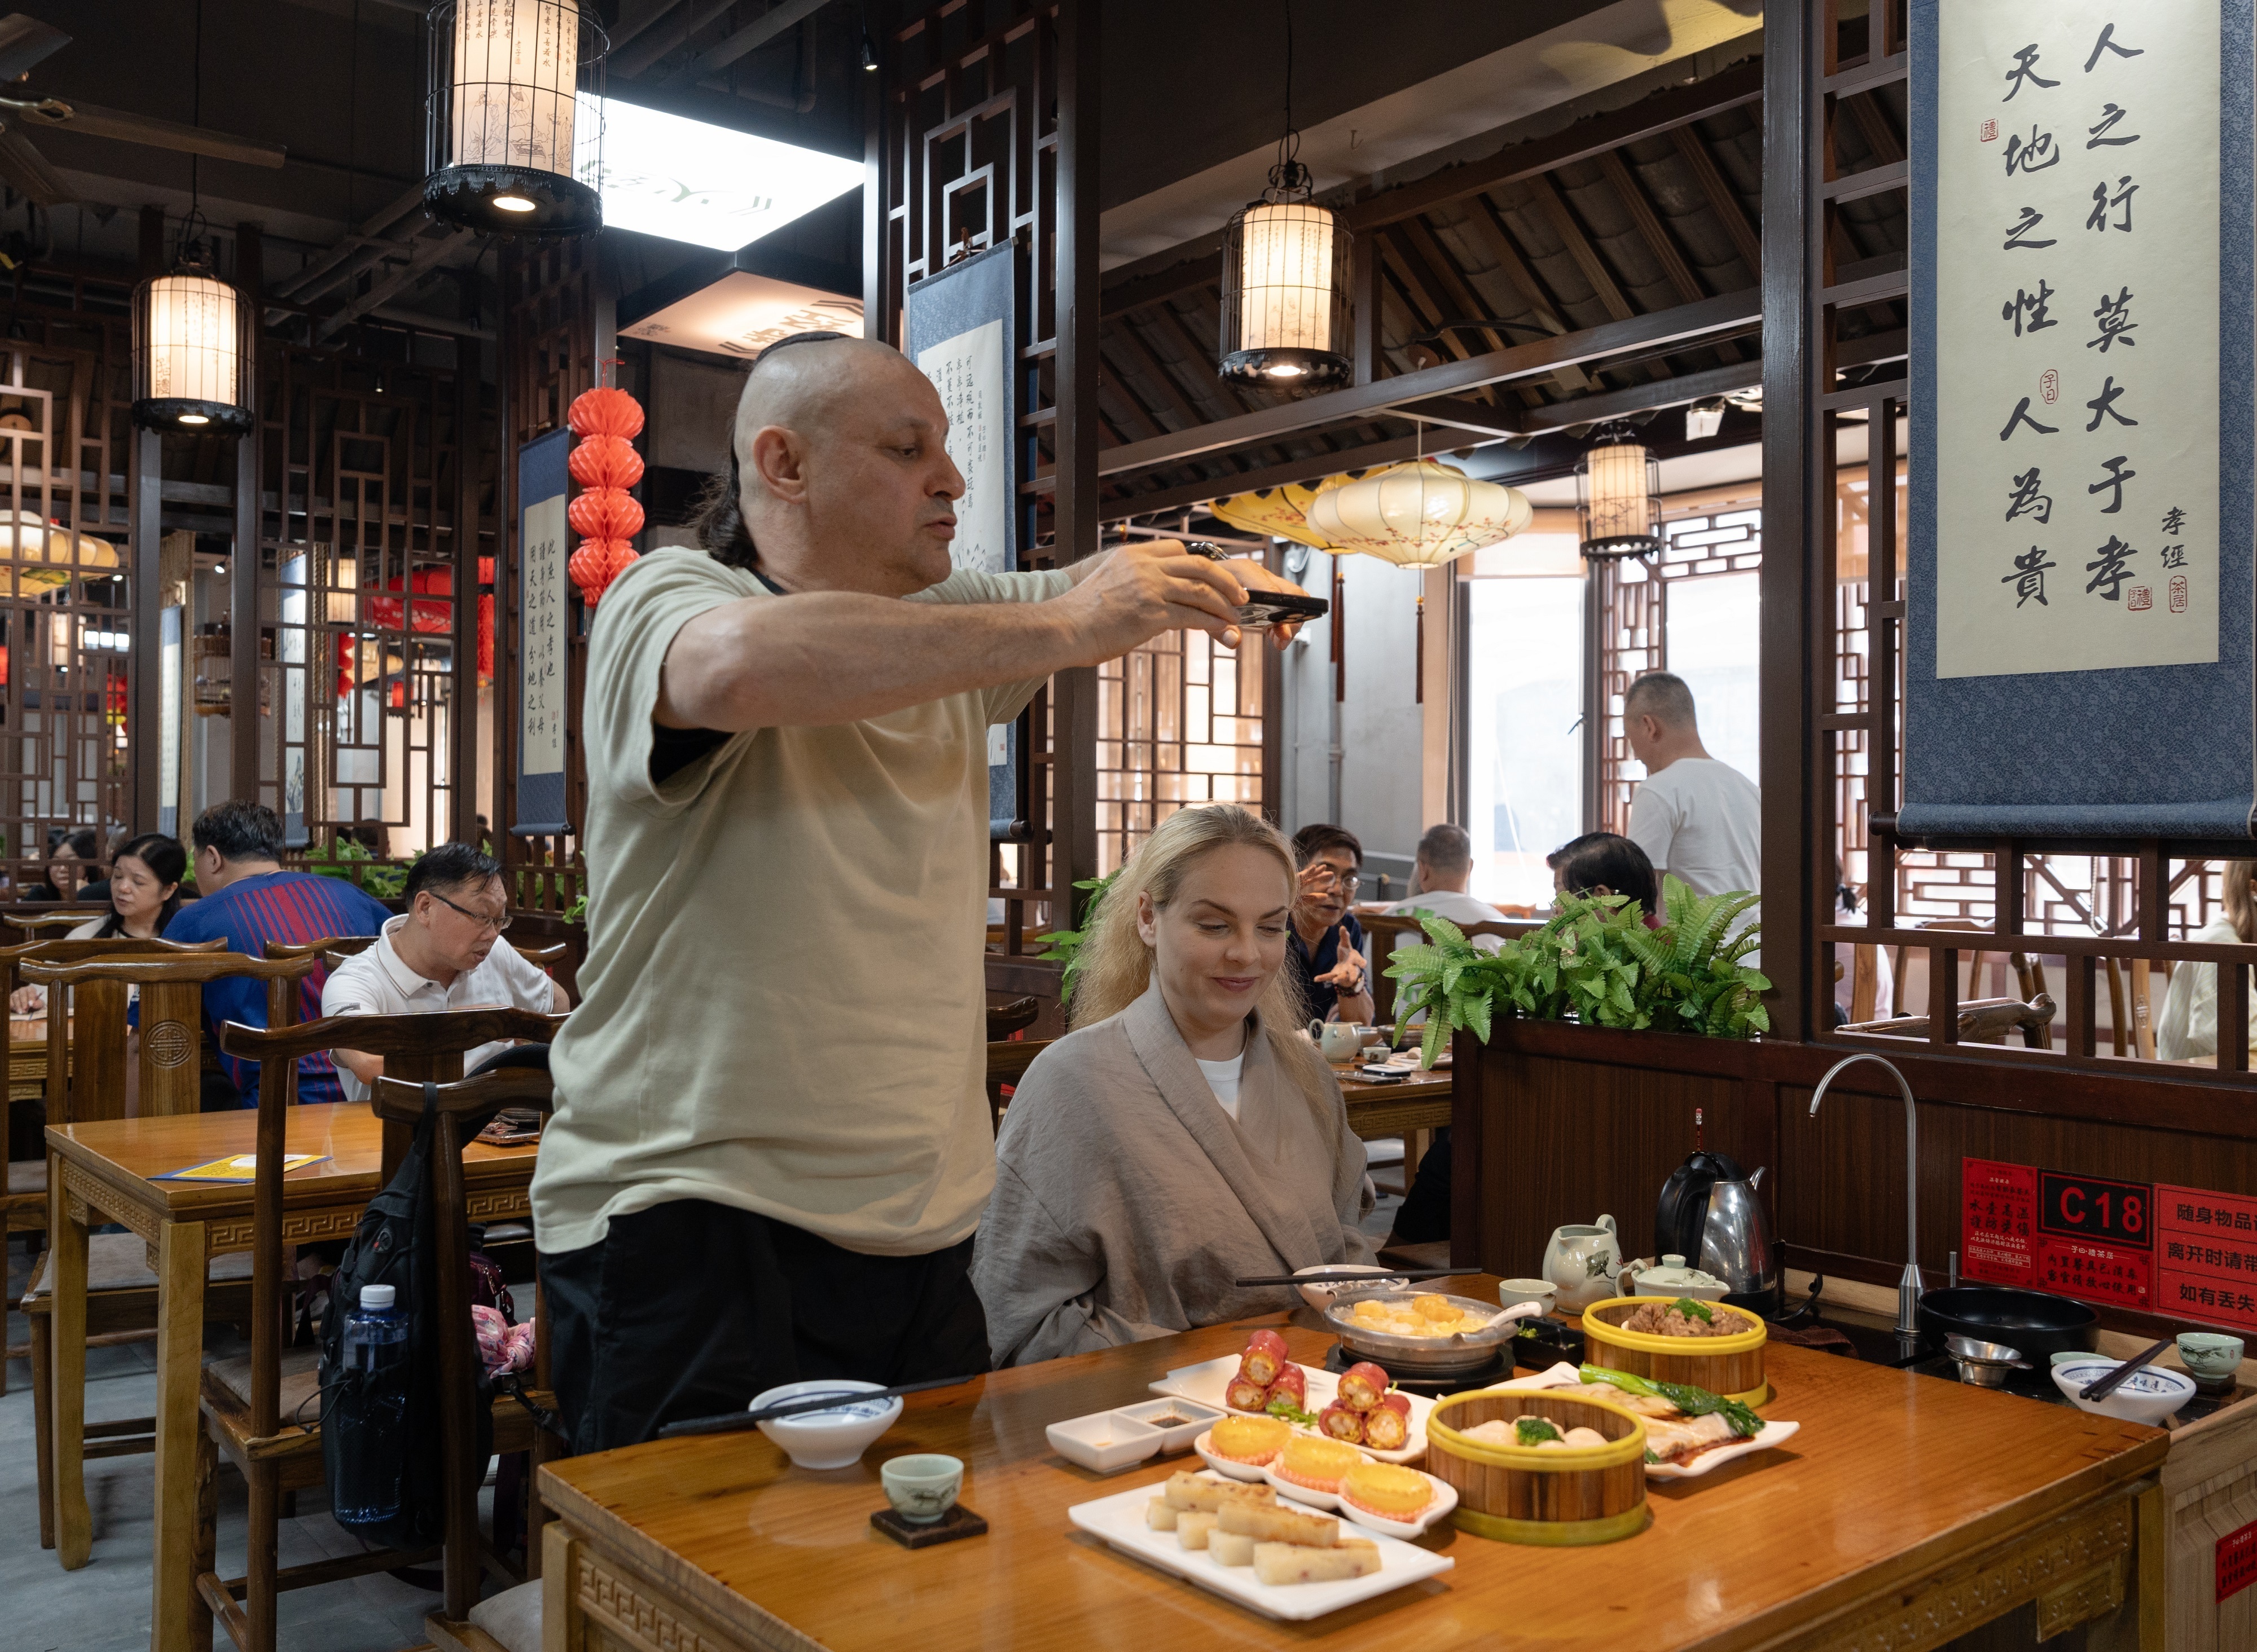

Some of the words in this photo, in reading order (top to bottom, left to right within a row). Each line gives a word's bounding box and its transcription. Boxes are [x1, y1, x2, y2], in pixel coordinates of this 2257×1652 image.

[2161, 507, 2189, 569] 孝經
[2060, 1187, 2142, 1233] C18
[2167, 1242, 2257, 1273] 离开时请带
[2180, 1283, 2255, 1313] 如有丢失
